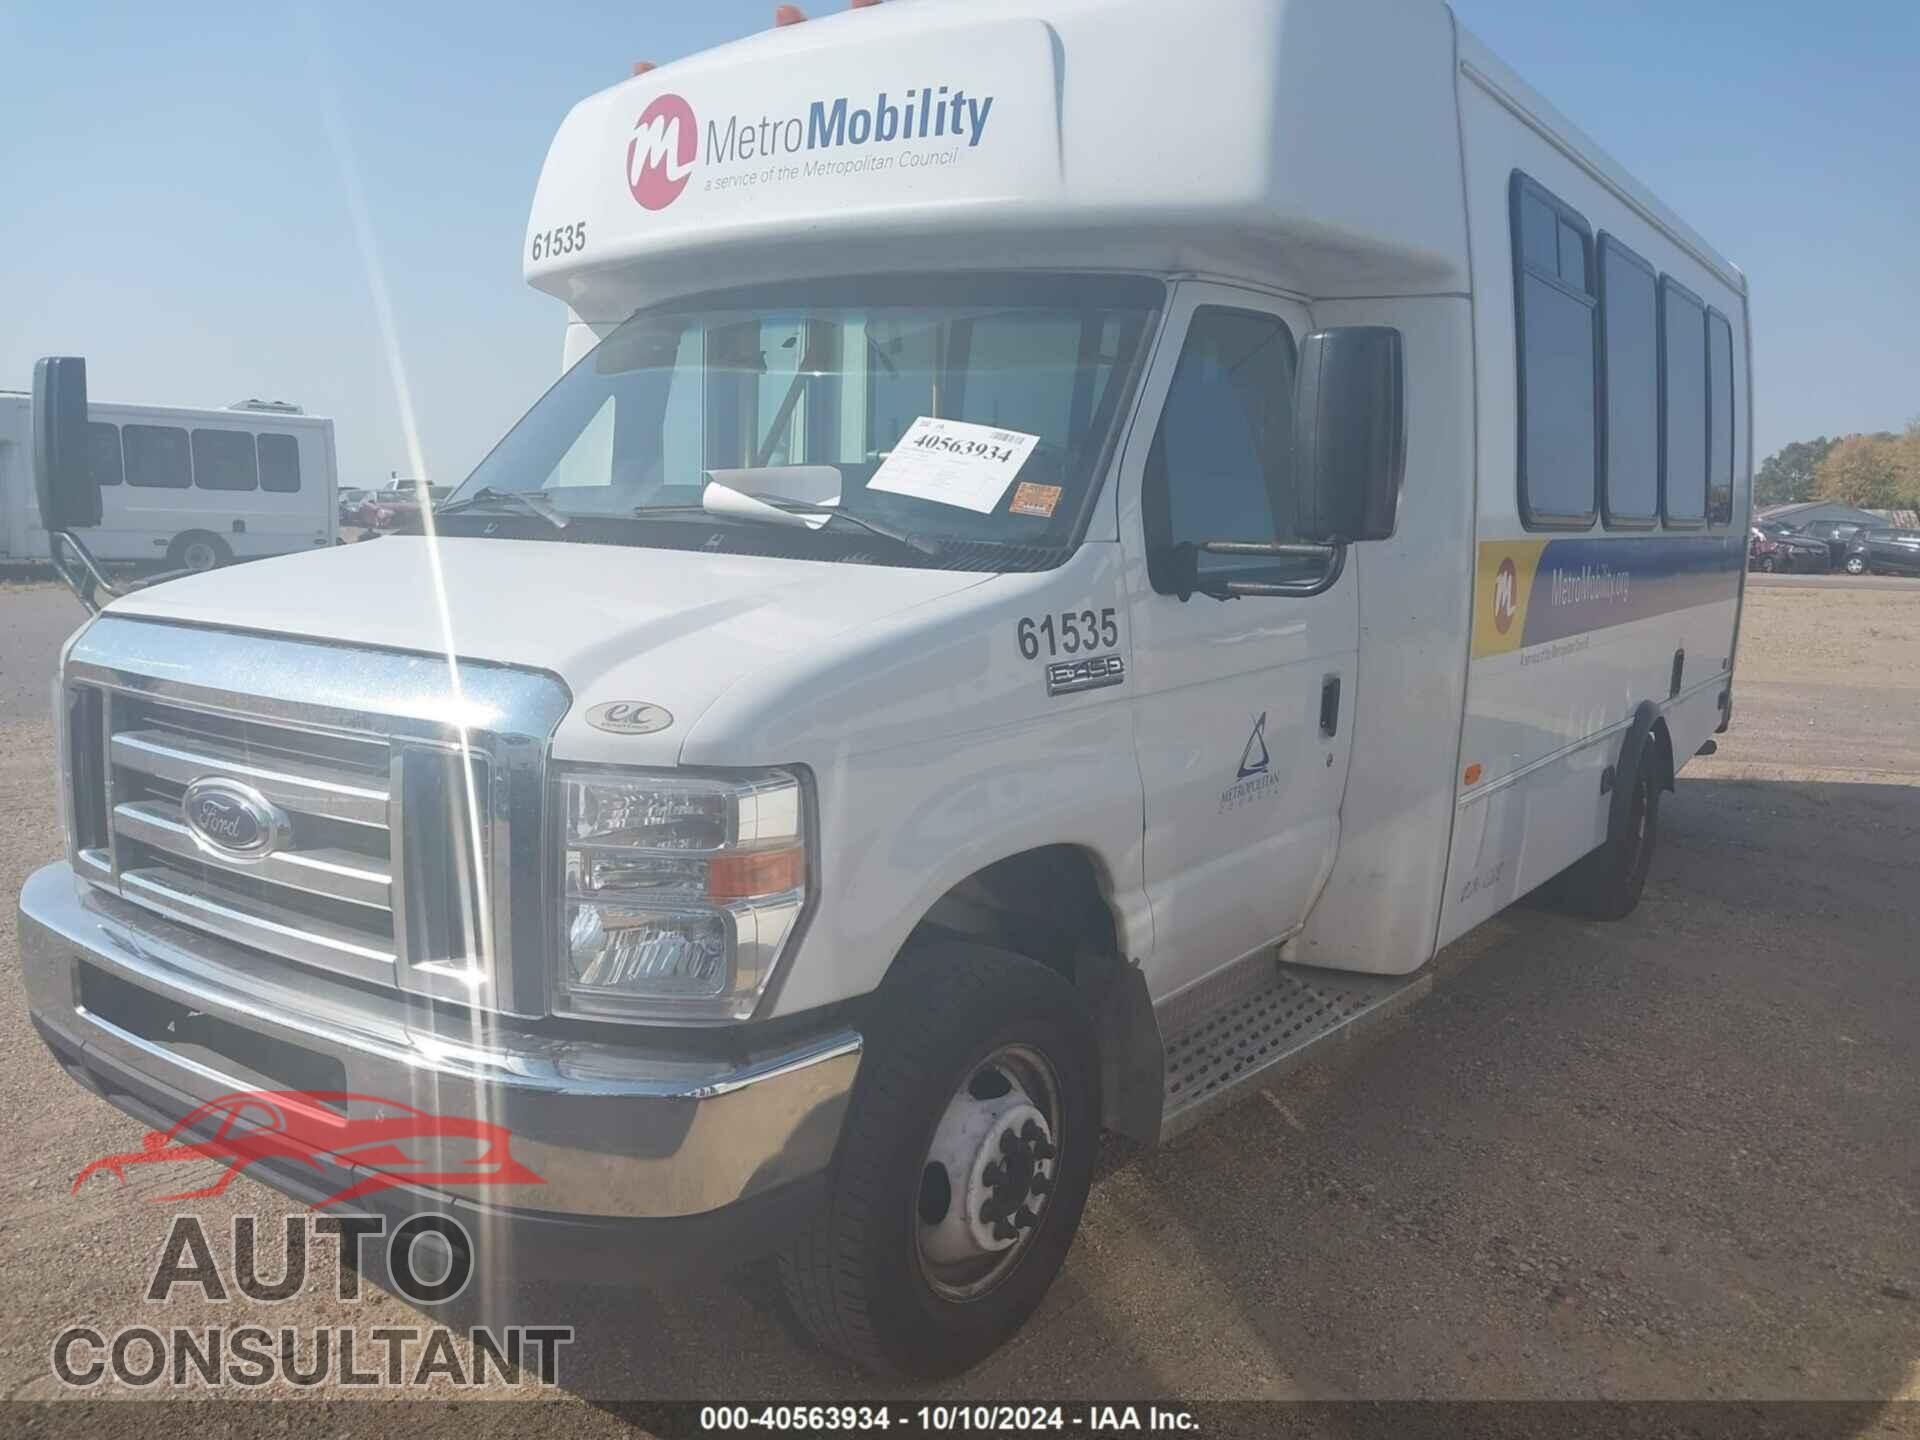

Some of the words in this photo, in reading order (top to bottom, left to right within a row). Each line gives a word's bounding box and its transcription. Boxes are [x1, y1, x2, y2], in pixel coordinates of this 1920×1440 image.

[705, 86, 994, 166] MetroMobility
[704, 178, 712, 191] a
[714, 170, 758, 189] service
[760, 166, 775, 183] of
[777, 163, 799, 181] the
[803, 154, 893, 178] Metropolitan
[898, 147, 960, 168] Council
[532, 221, 586, 261] 61535
[914, 433, 1013, 463] 40563934
[1017, 608, 1118, 660] 61535
[200, 800, 241, 837] Ford
